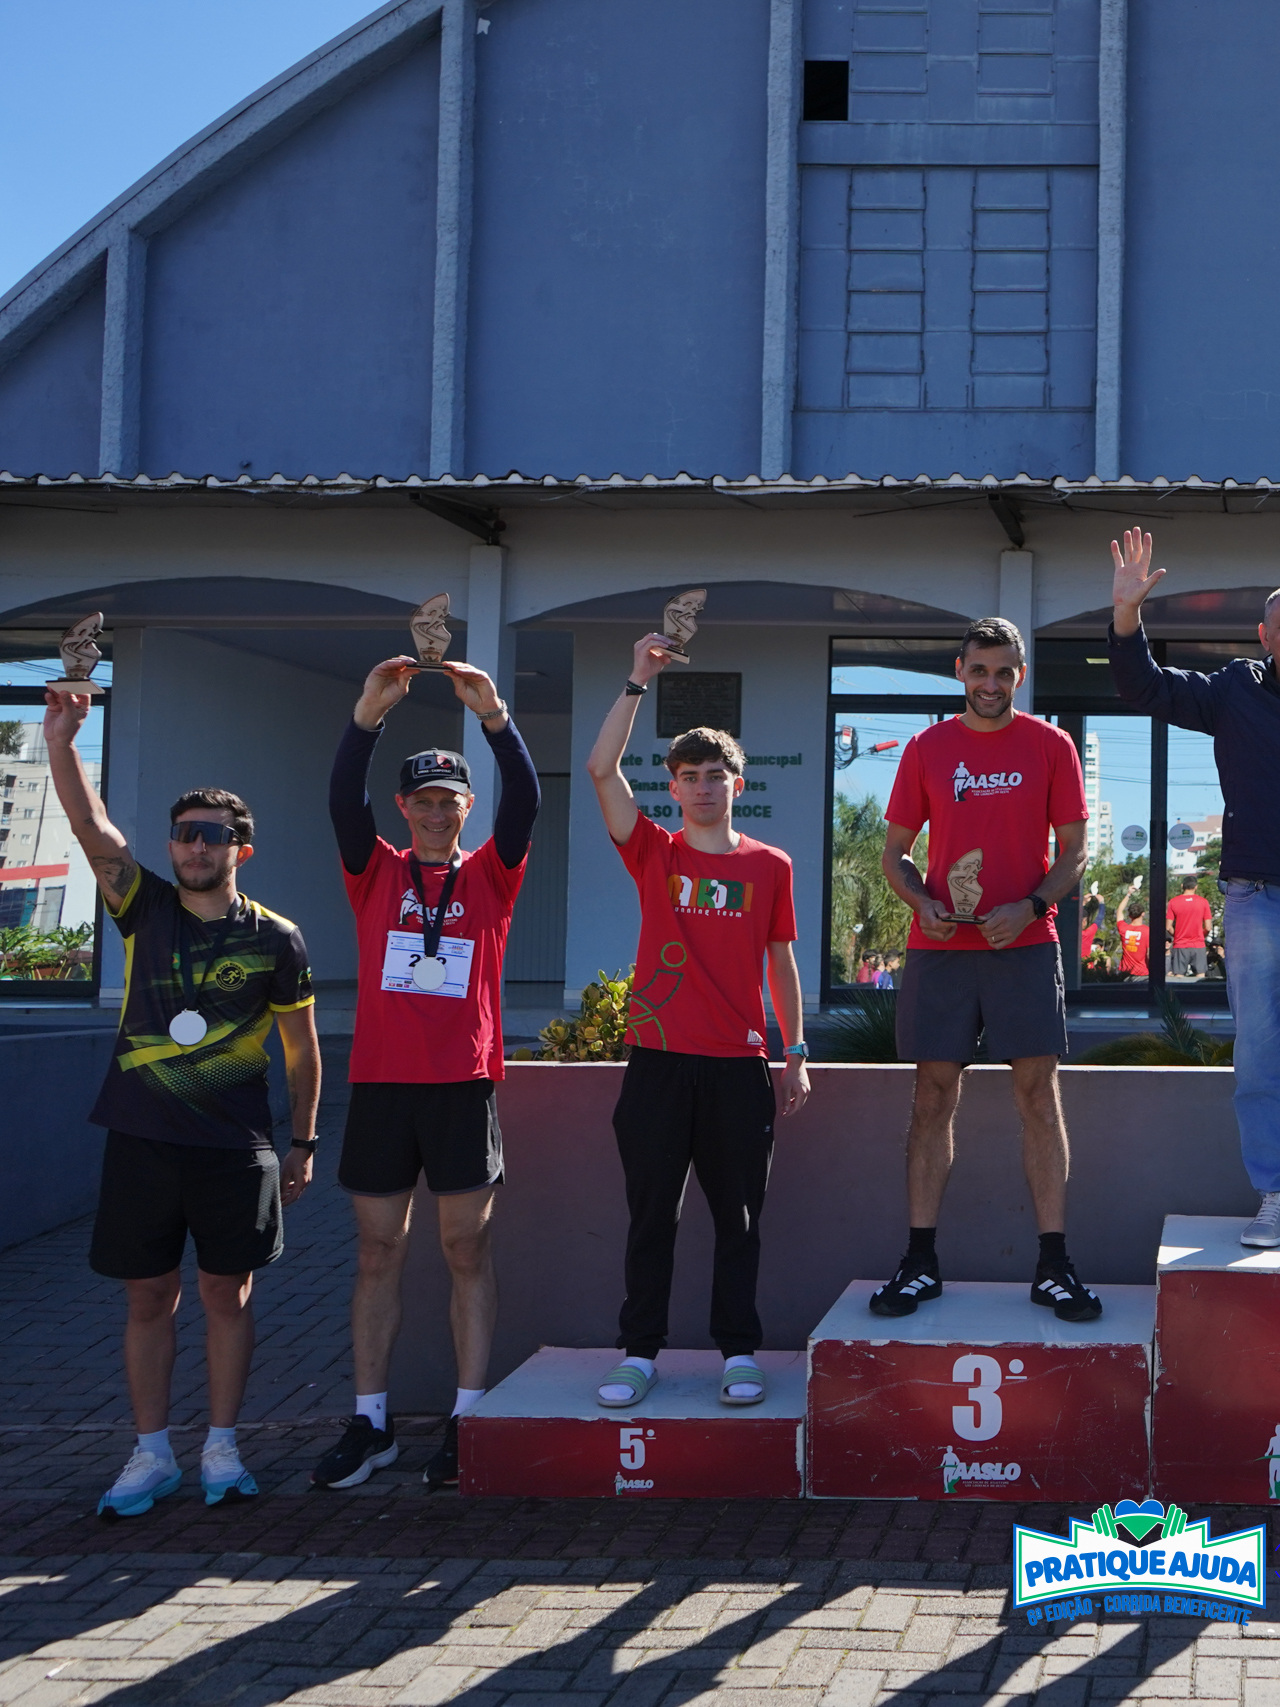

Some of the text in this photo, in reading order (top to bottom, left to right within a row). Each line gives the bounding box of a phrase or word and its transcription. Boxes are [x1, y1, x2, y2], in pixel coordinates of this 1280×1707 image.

[744, 753, 802, 768] unicipal
[963, 772, 1023, 789] AASLO
[732, 804, 772, 818] ROCE
[674, 906, 742, 918] unning team
[954, 1462, 1022, 1482] AASLO
[620, 1479, 654, 1489] AASLO
